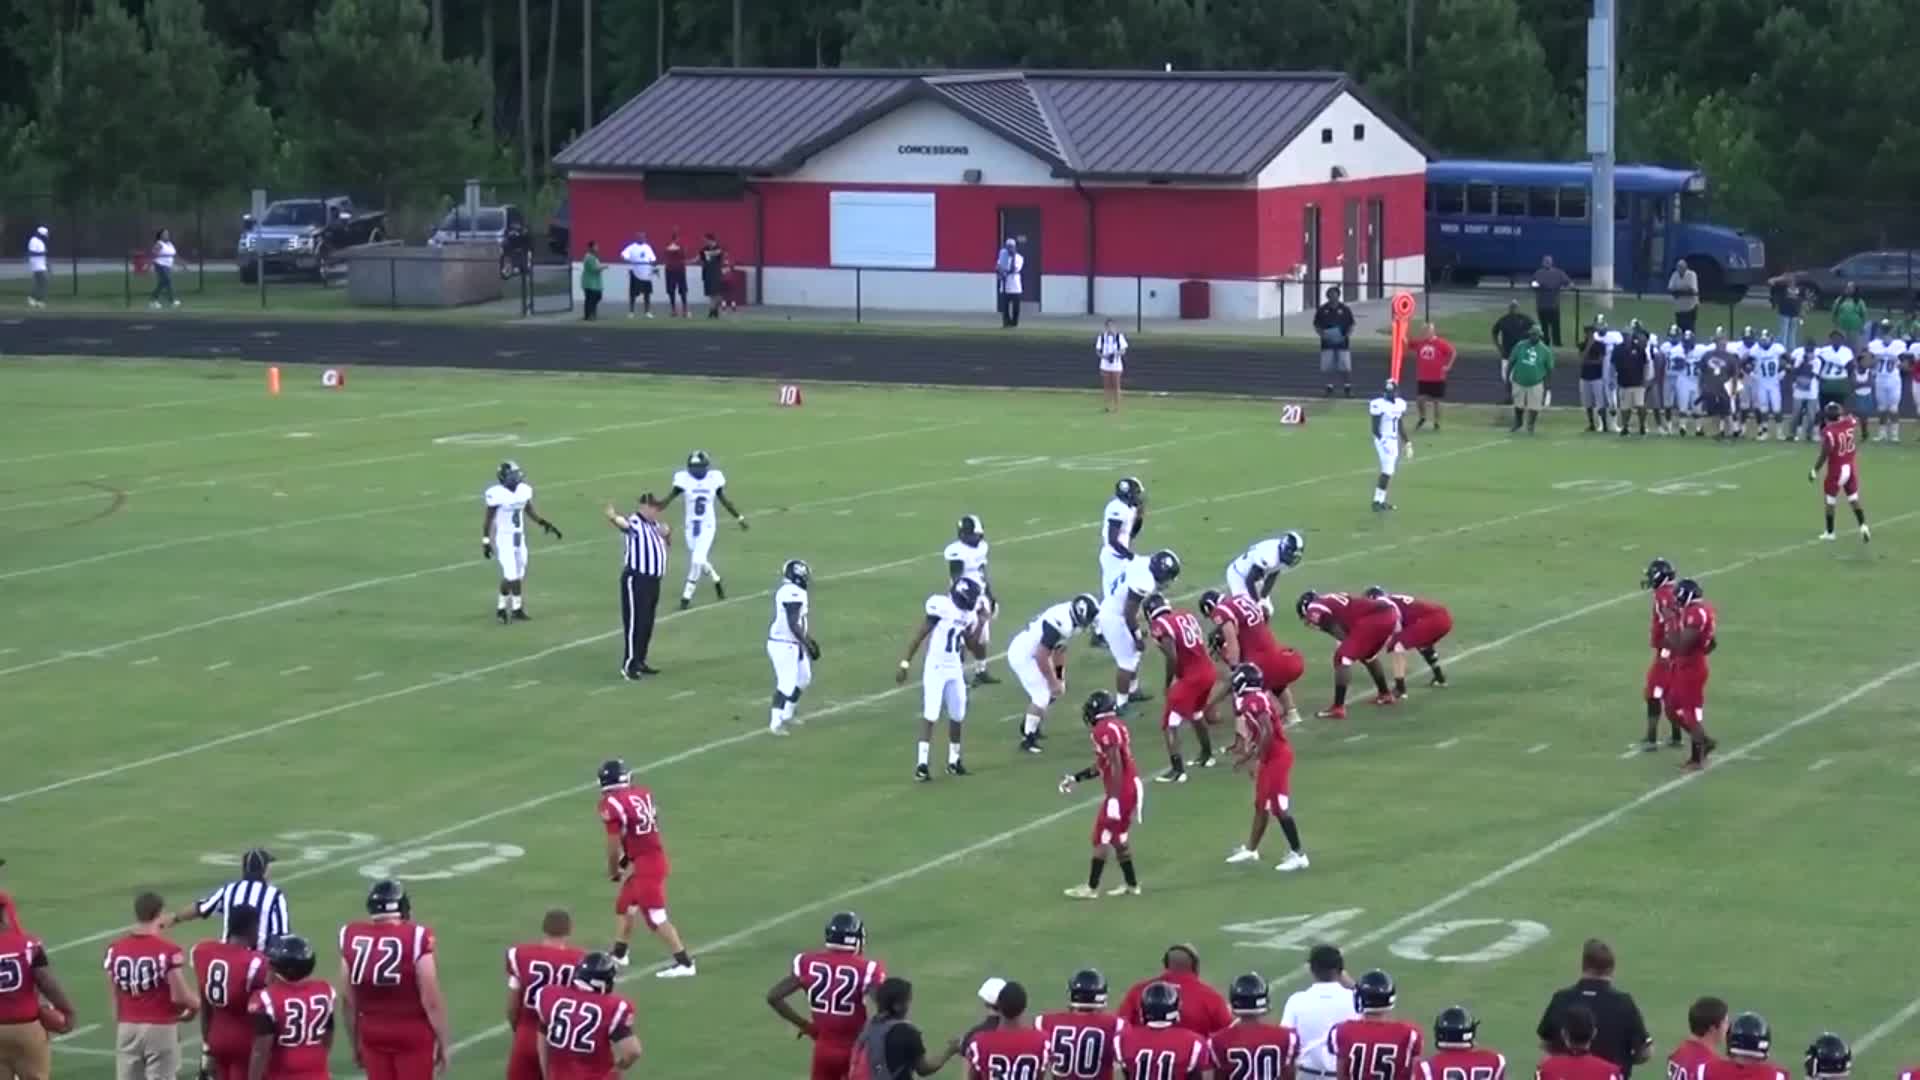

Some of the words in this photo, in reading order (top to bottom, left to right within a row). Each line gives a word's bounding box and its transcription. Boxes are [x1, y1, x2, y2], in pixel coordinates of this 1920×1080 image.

[897, 144, 969, 155] CONCESSIONS
[780, 385, 797, 405] 10
[1280, 404, 1302, 424] 20
[694, 495, 706, 516] 6
[351, 936, 401, 985] 72
[205, 959, 229, 1007] 8
[808, 961, 859, 1016] 22
[278, 994, 331, 1047] 32
[547, 998, 602, 1053] 62
[1052, 1025, 1105, 1078] 50
[1227, 1045, 1281, 1080] 20
[1349, 1043, 1399, 1080] 15
